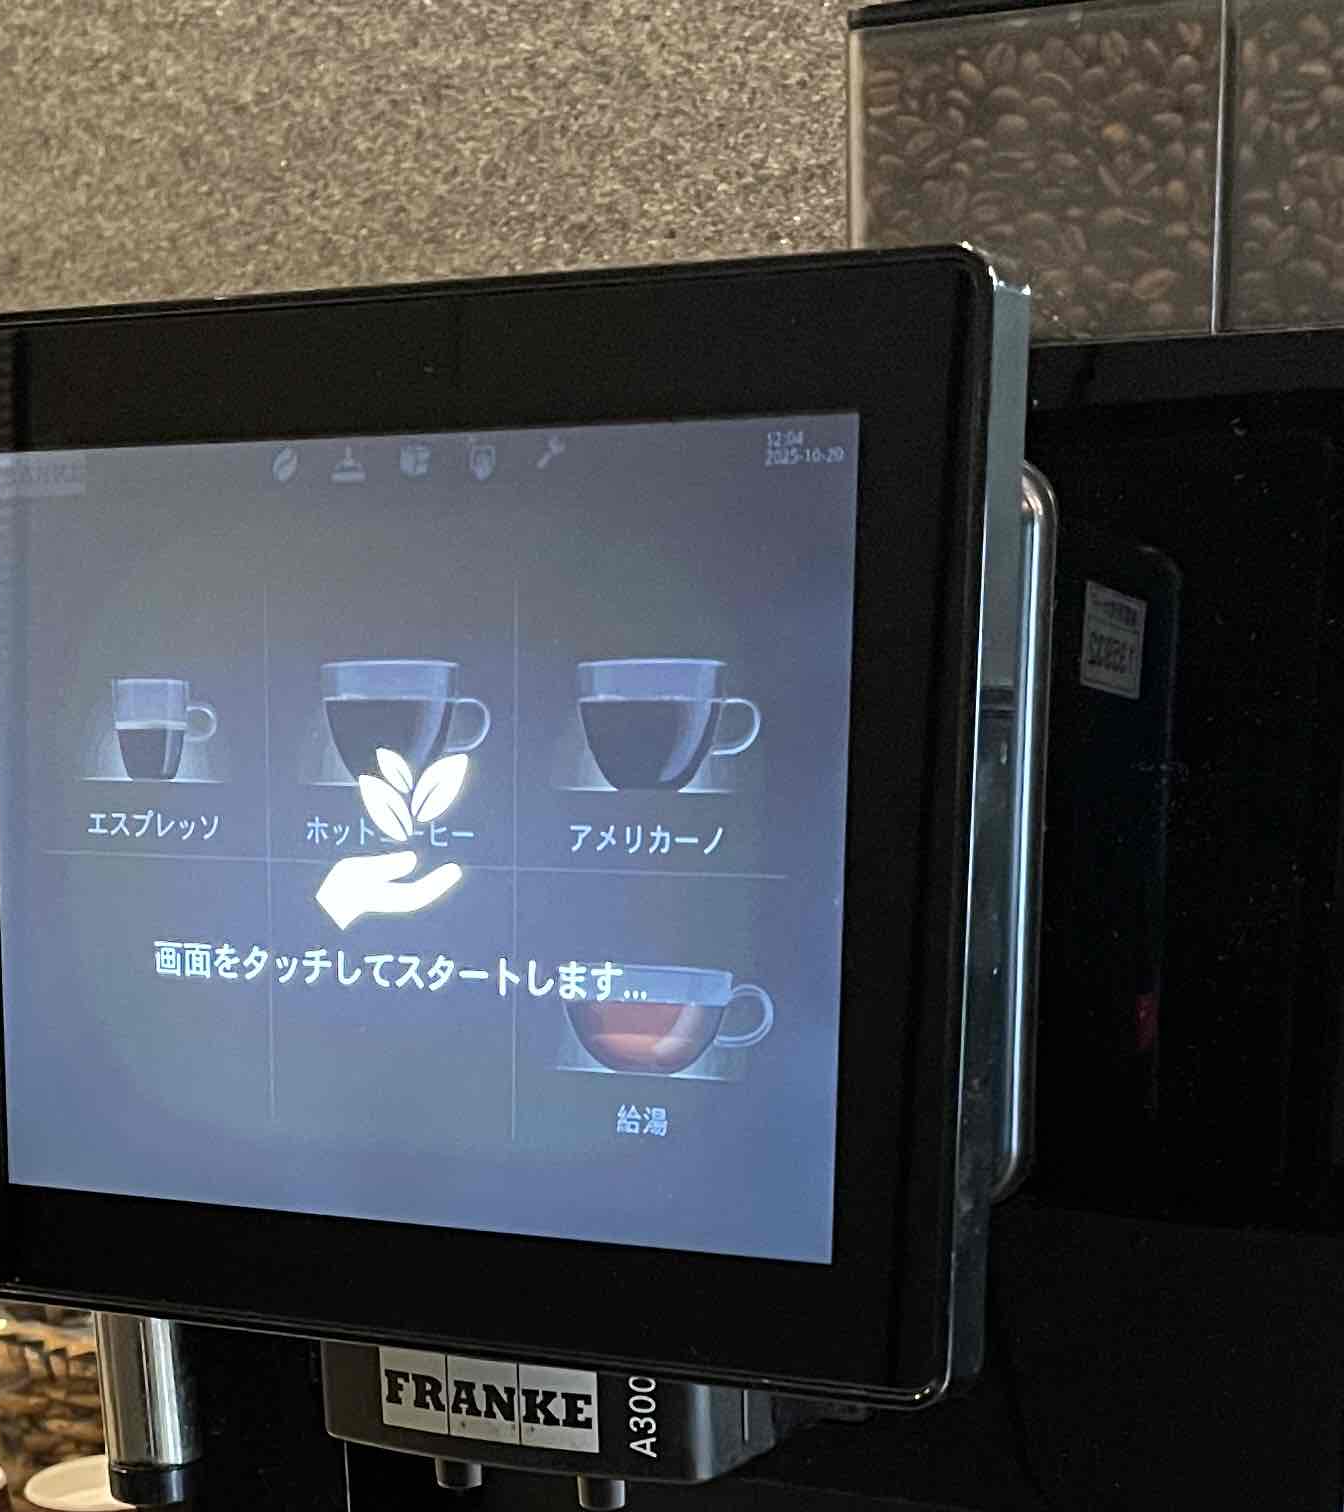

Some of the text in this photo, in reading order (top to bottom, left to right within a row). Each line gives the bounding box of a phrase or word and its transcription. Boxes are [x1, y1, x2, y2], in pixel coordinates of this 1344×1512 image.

[87, 811, 220, 841] エスプレッソ
[569, 824, 725, 856] アメリカーノ
[616, 1104, 668, 1137] 給湯
[384, 1368, 593, 1429] FRANKE
[629, 1375, 657, 1458] A300
